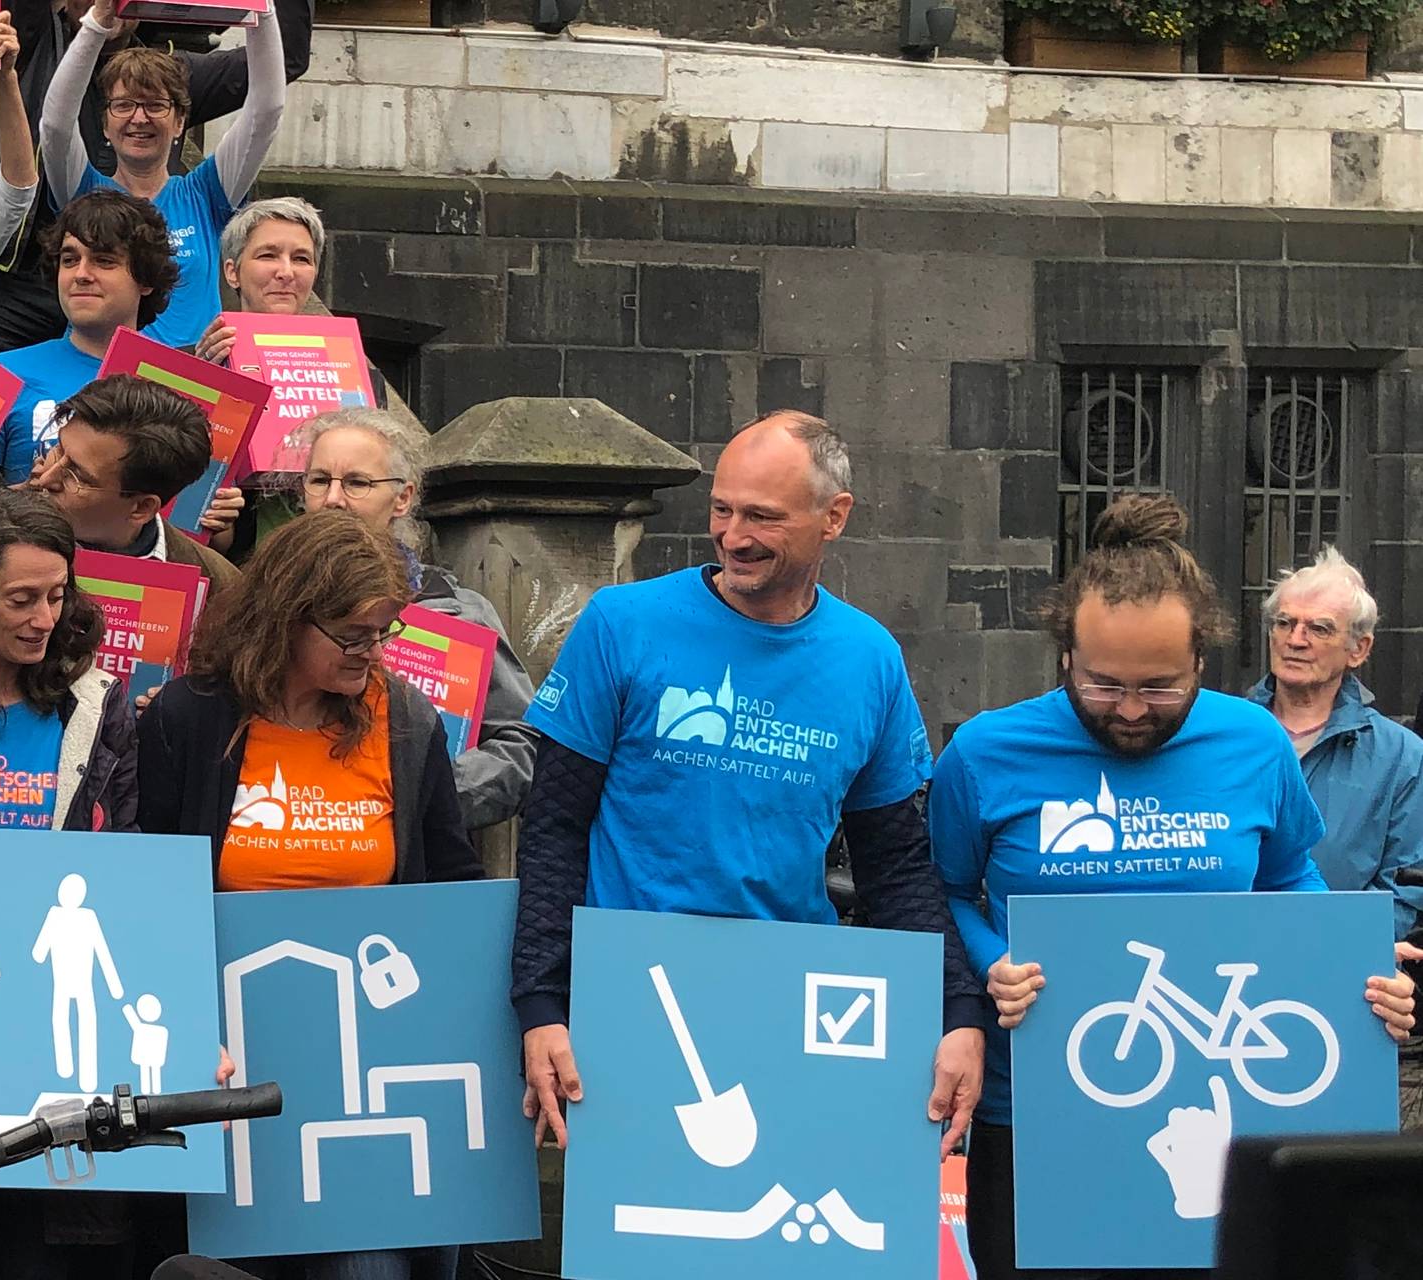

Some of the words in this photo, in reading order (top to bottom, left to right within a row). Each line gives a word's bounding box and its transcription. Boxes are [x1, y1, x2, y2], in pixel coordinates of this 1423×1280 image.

[265, 359, 290, 367] SCHON
[270, 368, 340, 384] AACHEN
[273, 386, 344, 401] SATTELT
[278, 404, 317, 418] AUF!
[103, 629, 145, 652] HEN
[400, 646, 437, 663] GEHÖRT?
[398, 658, 470, 686] UNTERSCHRIEBEN?
[736, 695, 775, 718] RAD
[734, 714, 839, 750] ENTSCHEID
[730, 733, 809, 762] AACHEN
[652, 748, 717, 769] AACHEN
[719, 757, 779, 781] SATTELT
[781, 769, 816, 788] AUF!
[289, 785, 325, 801] RAD
[290, 800, 384, 816] ENTSCHEID
[1119, 796, 1160, 815] RAD
[290, 817, 365, 832] AACHEN
[1120, 812, 1231, 833] ENTSCHEID
[224, 833, 279, 849] ACHEN
[284, 838, 345, 851] SATTELT
[350, 839, 379, 852] AUF!
[1121, 830, 1207, 852] AACHEN
[1039, 860, 1109, 876] AACHEN
[1114, 857, 1182, 874] SATTELT
[1187, 856, 1223, 871] AUF!
